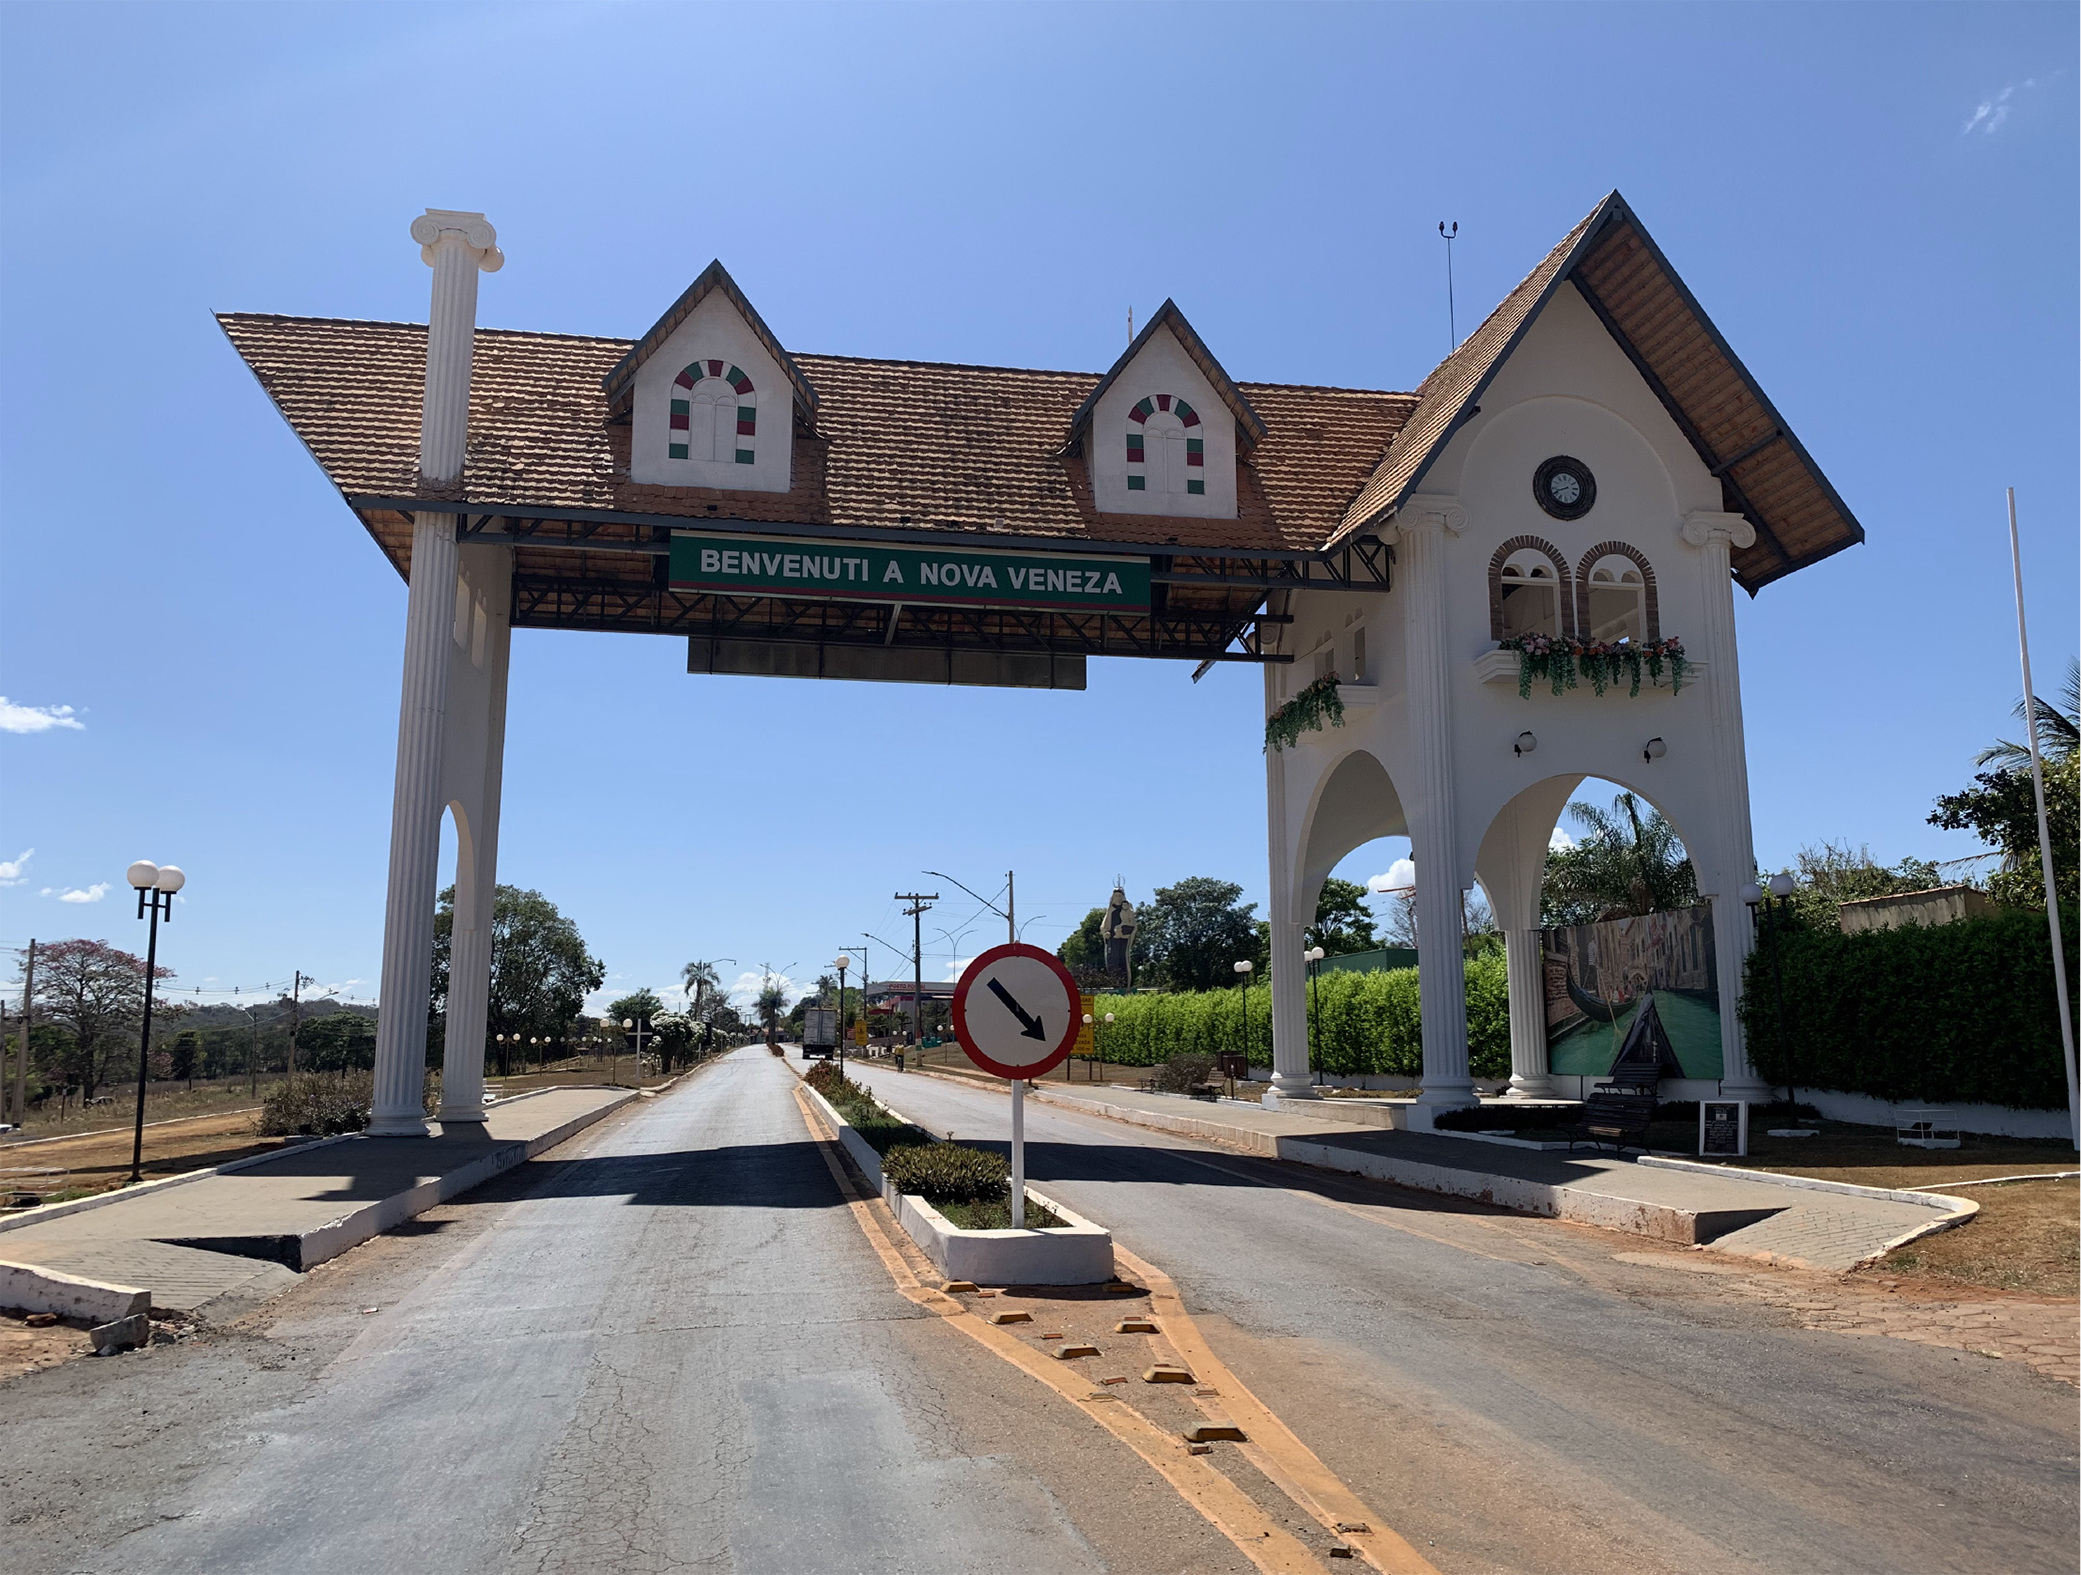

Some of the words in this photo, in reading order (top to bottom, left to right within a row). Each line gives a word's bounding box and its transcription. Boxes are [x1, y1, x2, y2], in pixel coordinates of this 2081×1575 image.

[701, 549, 868, 581] BENVENUTI
[882, 560, 904, 583] A
[920, 562, 998, 588] NOVA
[1007, 567, 1123, 594] VENEZA
